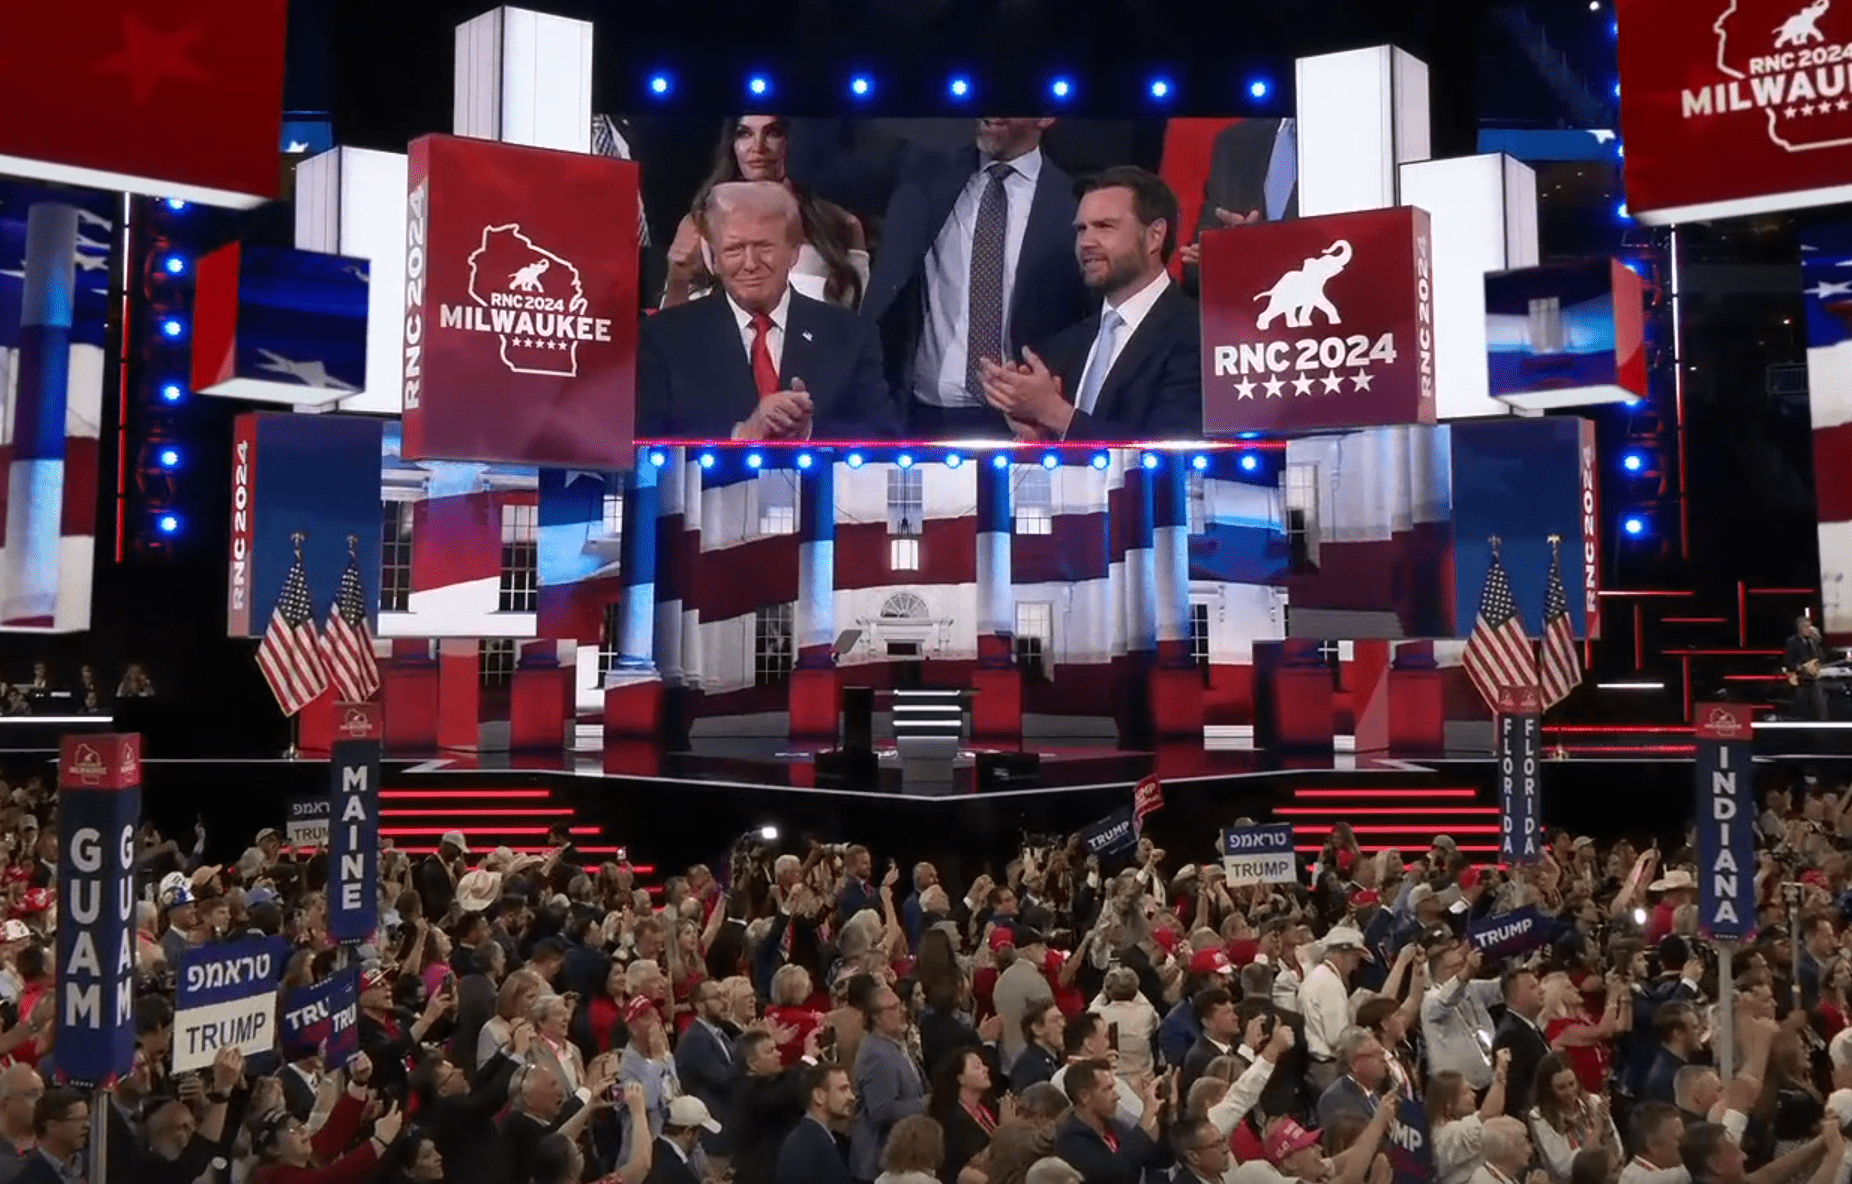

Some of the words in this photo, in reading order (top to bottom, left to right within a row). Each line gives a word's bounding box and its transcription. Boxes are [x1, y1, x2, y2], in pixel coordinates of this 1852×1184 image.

[1681, 62, 1852, 119] MILWAU
[1749, 52, 1796, 75] RNC
[407, 185, 426, 308] 2024
[1416, 234, 1431, 325] 2024
[440, 303, 612, 342] MILWAUKEE
[490, 292, 524, 309] RNC
[524, 296, 565, 312] 2024
[404, 314, 422, 410] RNC
[1214, 341, 1291, 376] RNC
[1294, 332, 1397, 371] 2024
[1419, 328, 1432, 398] RNC
[234, 440, 248, 533] 2024
[1582, 446, 1595, 537] 2024
[232, 537, 246, 611] RNC
[1584, 540, 1597, 613] RNC
[1503, 717, 1514, 855] FLORIDA
[1524, 718, 1535, 856] FLORIDA
[340, 765, 367, 910] MAINE
[1088, 821, 1130, 848] TRUMP
[1229, 832, 1287, 849] טראמפ
[1231, 861, 1289, 878] TRUMP
[1712, 746, 1738, 924] INDIANA
[66, 828, 101, 1029] GUAM
[116, 825, 133, 1026] GUAM
[1475, 917, 1533, 948] TRUMP
[186, 953, 271, 992] טראמפ
[186, 1012, 266, 1054] TRUMP
